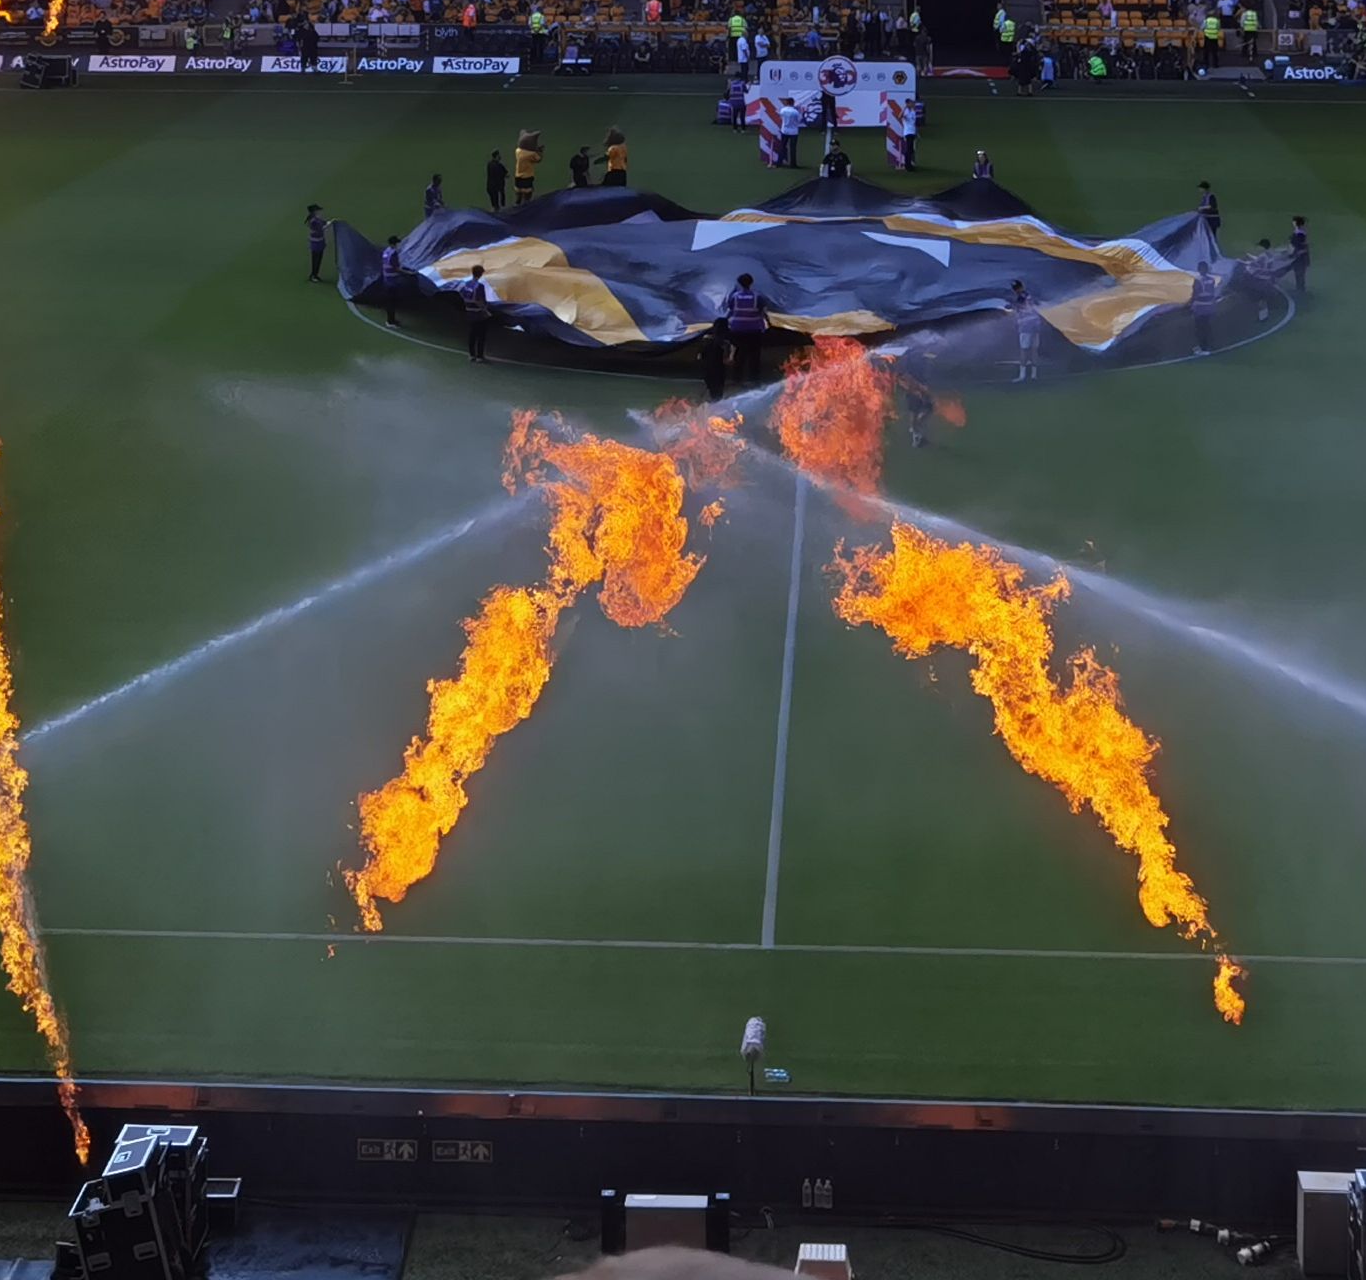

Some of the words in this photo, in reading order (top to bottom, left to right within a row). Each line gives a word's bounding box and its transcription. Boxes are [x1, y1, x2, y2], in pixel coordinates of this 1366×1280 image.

[98, 54, 165, 71] AstroPay
[184, 56, 251, 72] AstroPay
[271, 56, 337, 72] AstrPay
[357, 57, 424, 72] AstroPay
[445, 57, 509, 72] AstroPay
